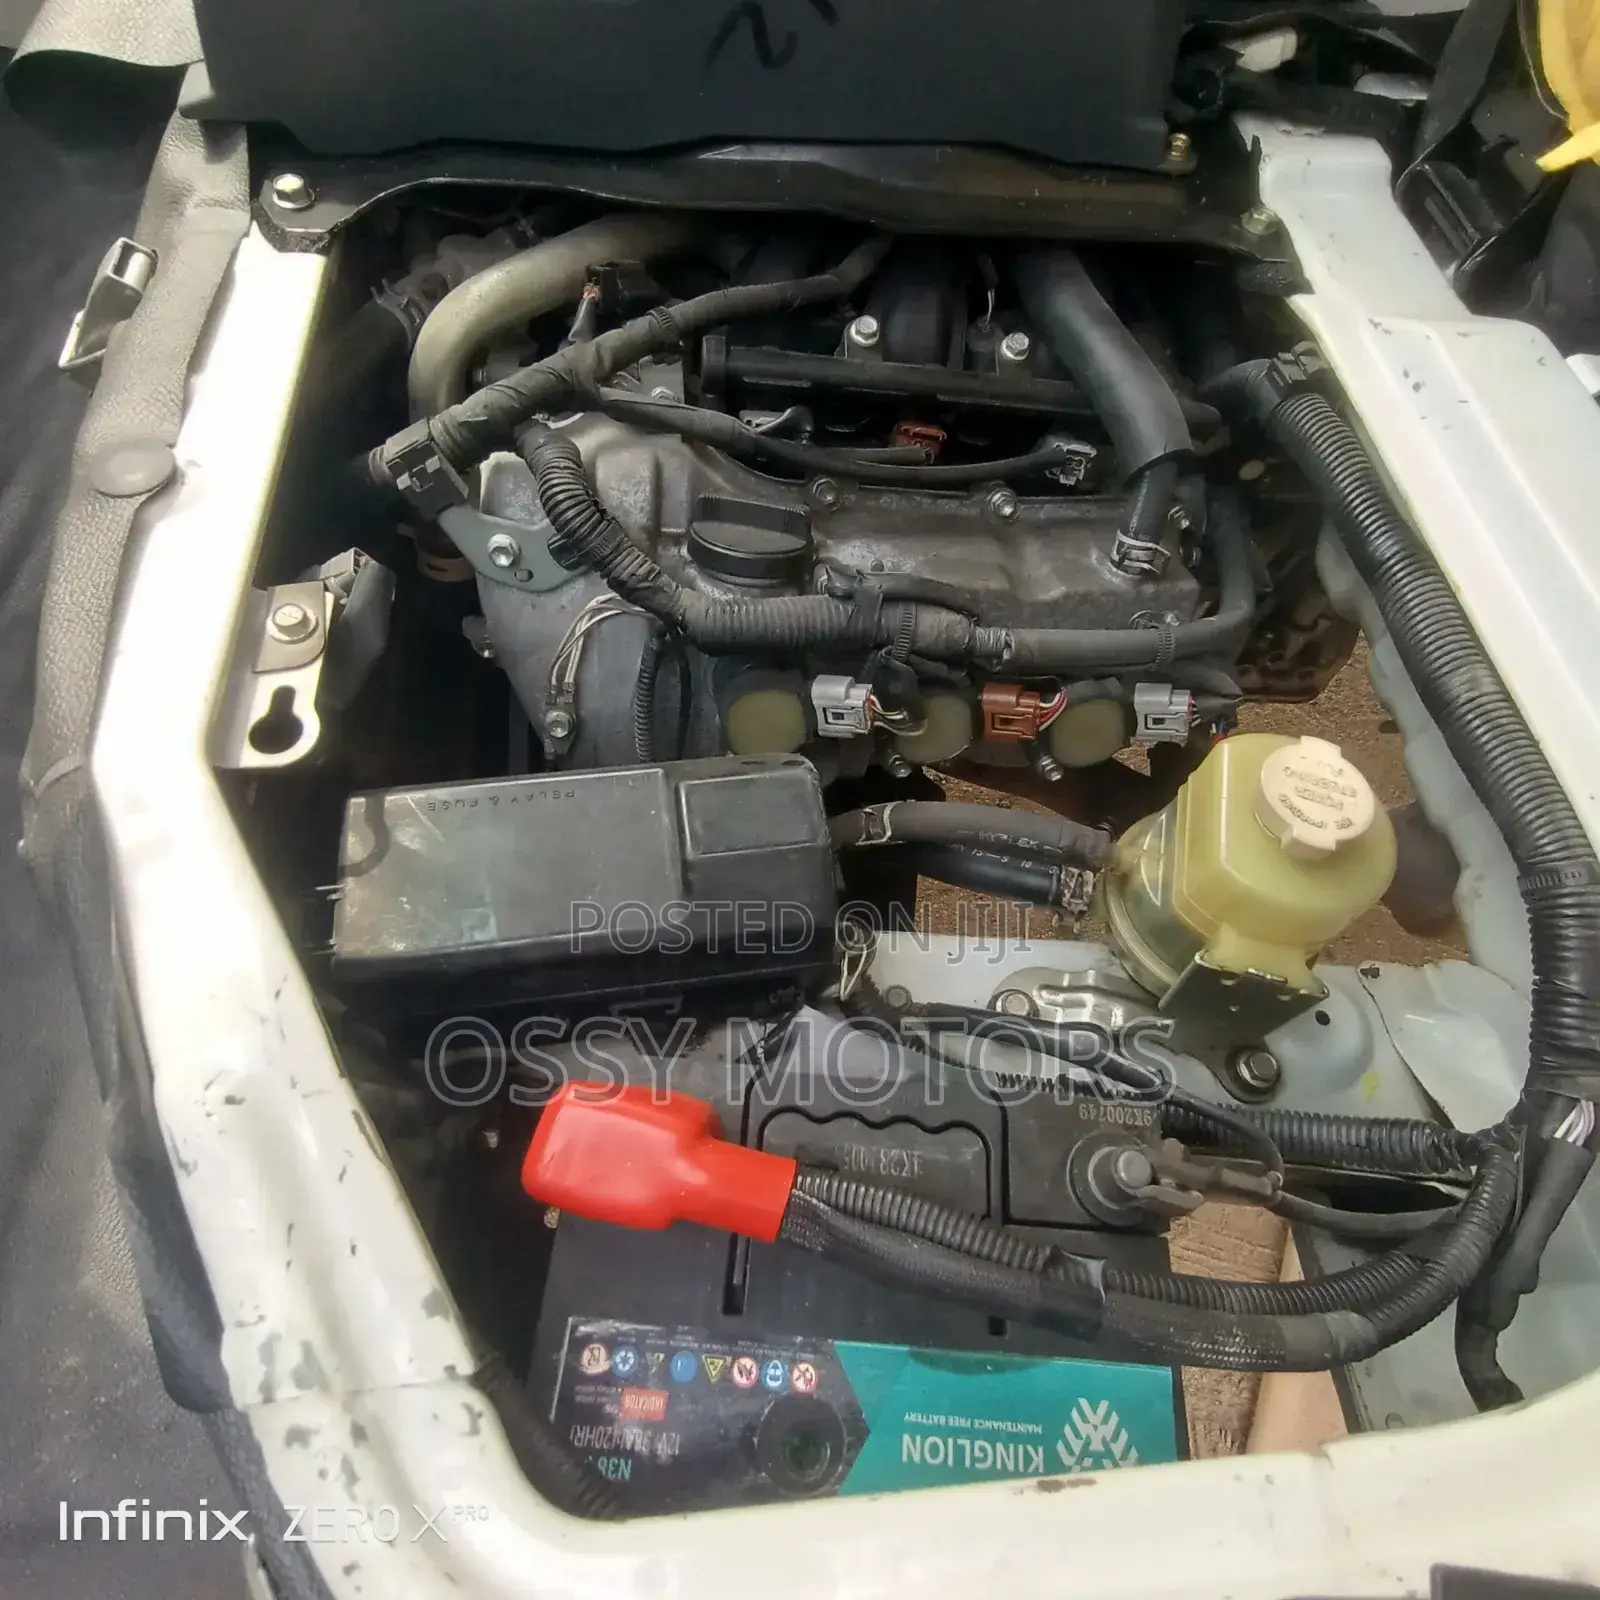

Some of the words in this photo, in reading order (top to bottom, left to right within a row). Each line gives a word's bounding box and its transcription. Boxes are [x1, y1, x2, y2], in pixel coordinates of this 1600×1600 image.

[427, 798, 479, 812] FUSE
[622, 1393, 665, 1413] INDICATOR
[903, 1411, 947, 1427] BATTERY
[947, 1416, 971, 1430] FREE
[972, 1418, 1043, 1436] MAINTENANCE
[901, 1432, 1045, 1474] KINGLION
